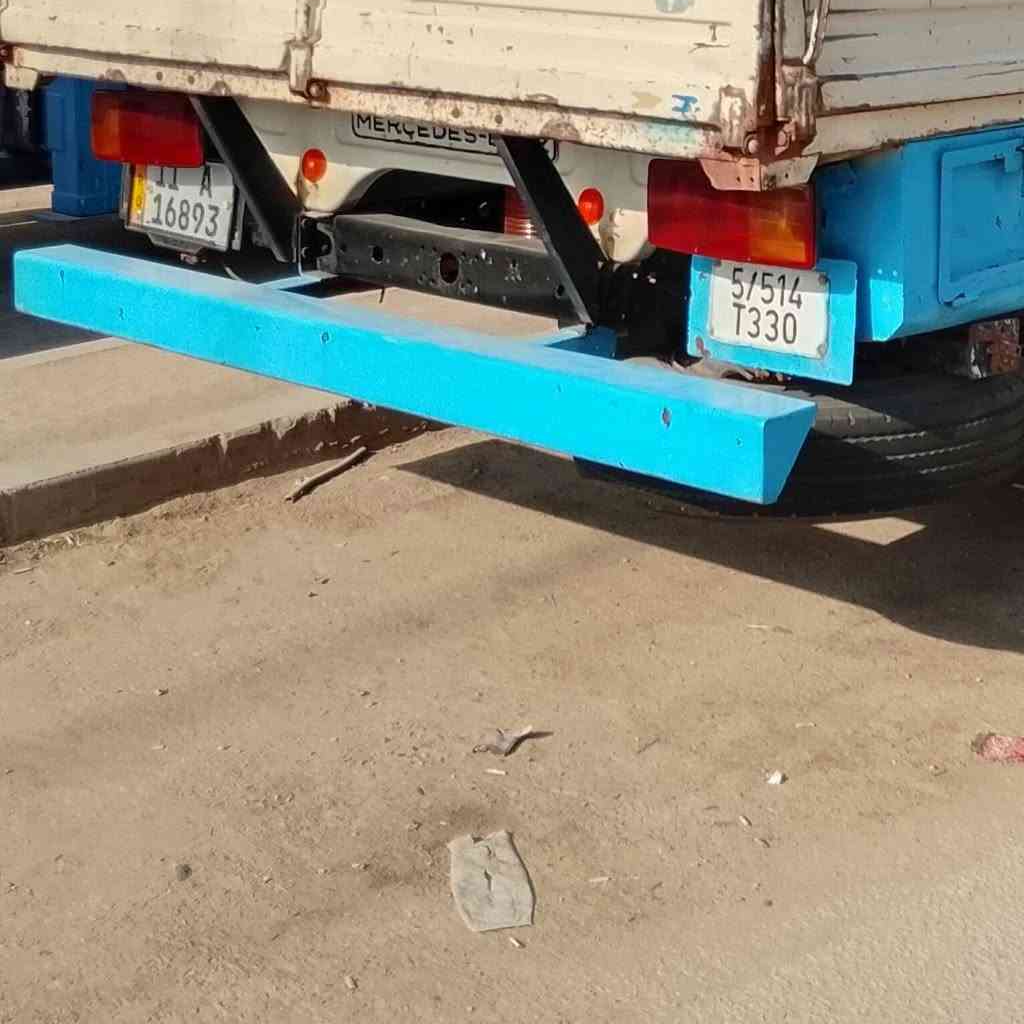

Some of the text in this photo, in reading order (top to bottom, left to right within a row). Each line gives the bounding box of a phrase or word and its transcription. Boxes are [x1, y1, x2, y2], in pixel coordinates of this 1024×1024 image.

[200, 165, 212, 198] A
[151, 193, 220, 237] 16893
[731, 267, 802, 309] 5/514
[732, 302, 797, 345] T330
